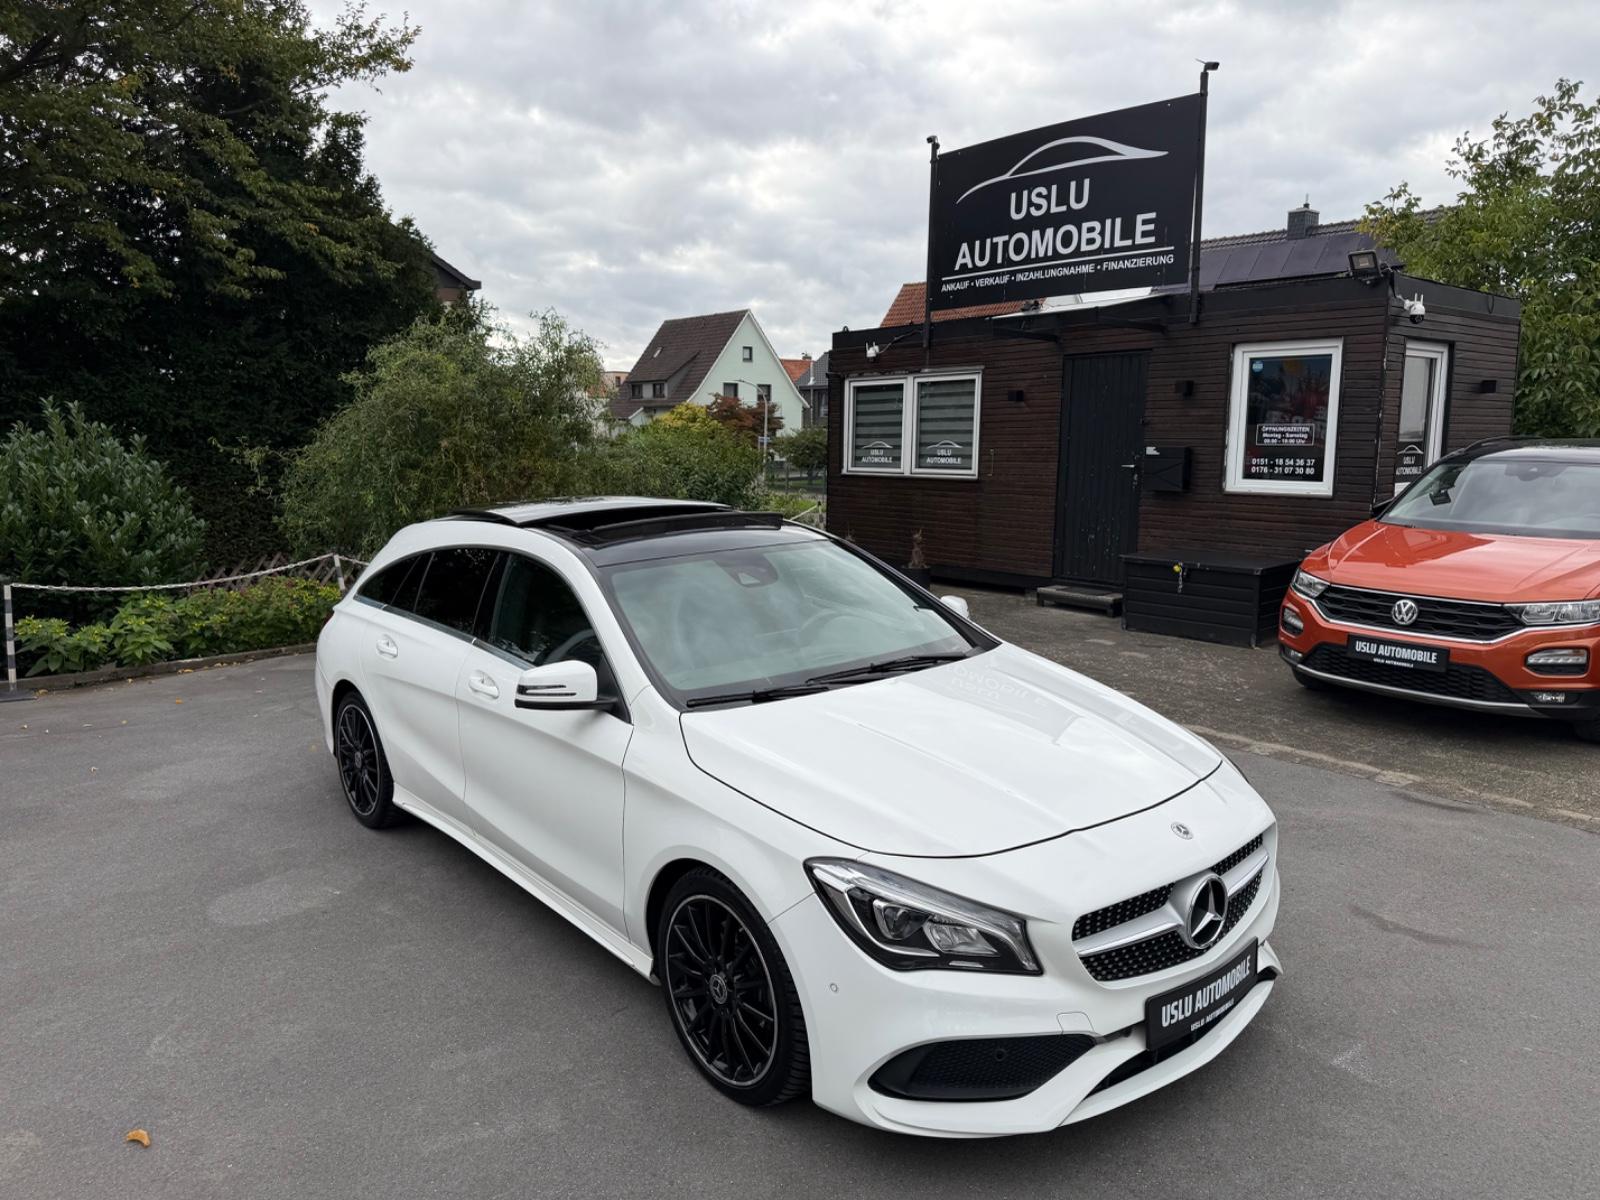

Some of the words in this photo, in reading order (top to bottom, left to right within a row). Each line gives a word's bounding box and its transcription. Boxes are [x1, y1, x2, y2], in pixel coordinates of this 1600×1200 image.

[1010, 178, 1090, 220] USLU
[954, 212, 1157, 271] AUTOMOBILE
[941, 281, 970, 293] ANKAUF
[975, 275, 1010, 288] VERKAUF
[1015, 263, 1095, 281] INZAHLUNGNAHME
[1102, 254, 1174, 271] FINANZIERUNG
[1285, 458, 1294, 466] 54
[1355, 640, 1377, 654] USLU
[1378, 644, 1438, 664] AUTOMOBILE
[1161, 994, 1193, 1027] USLU
[1194, 954, 1251, 1013] AUTOMOBILE
